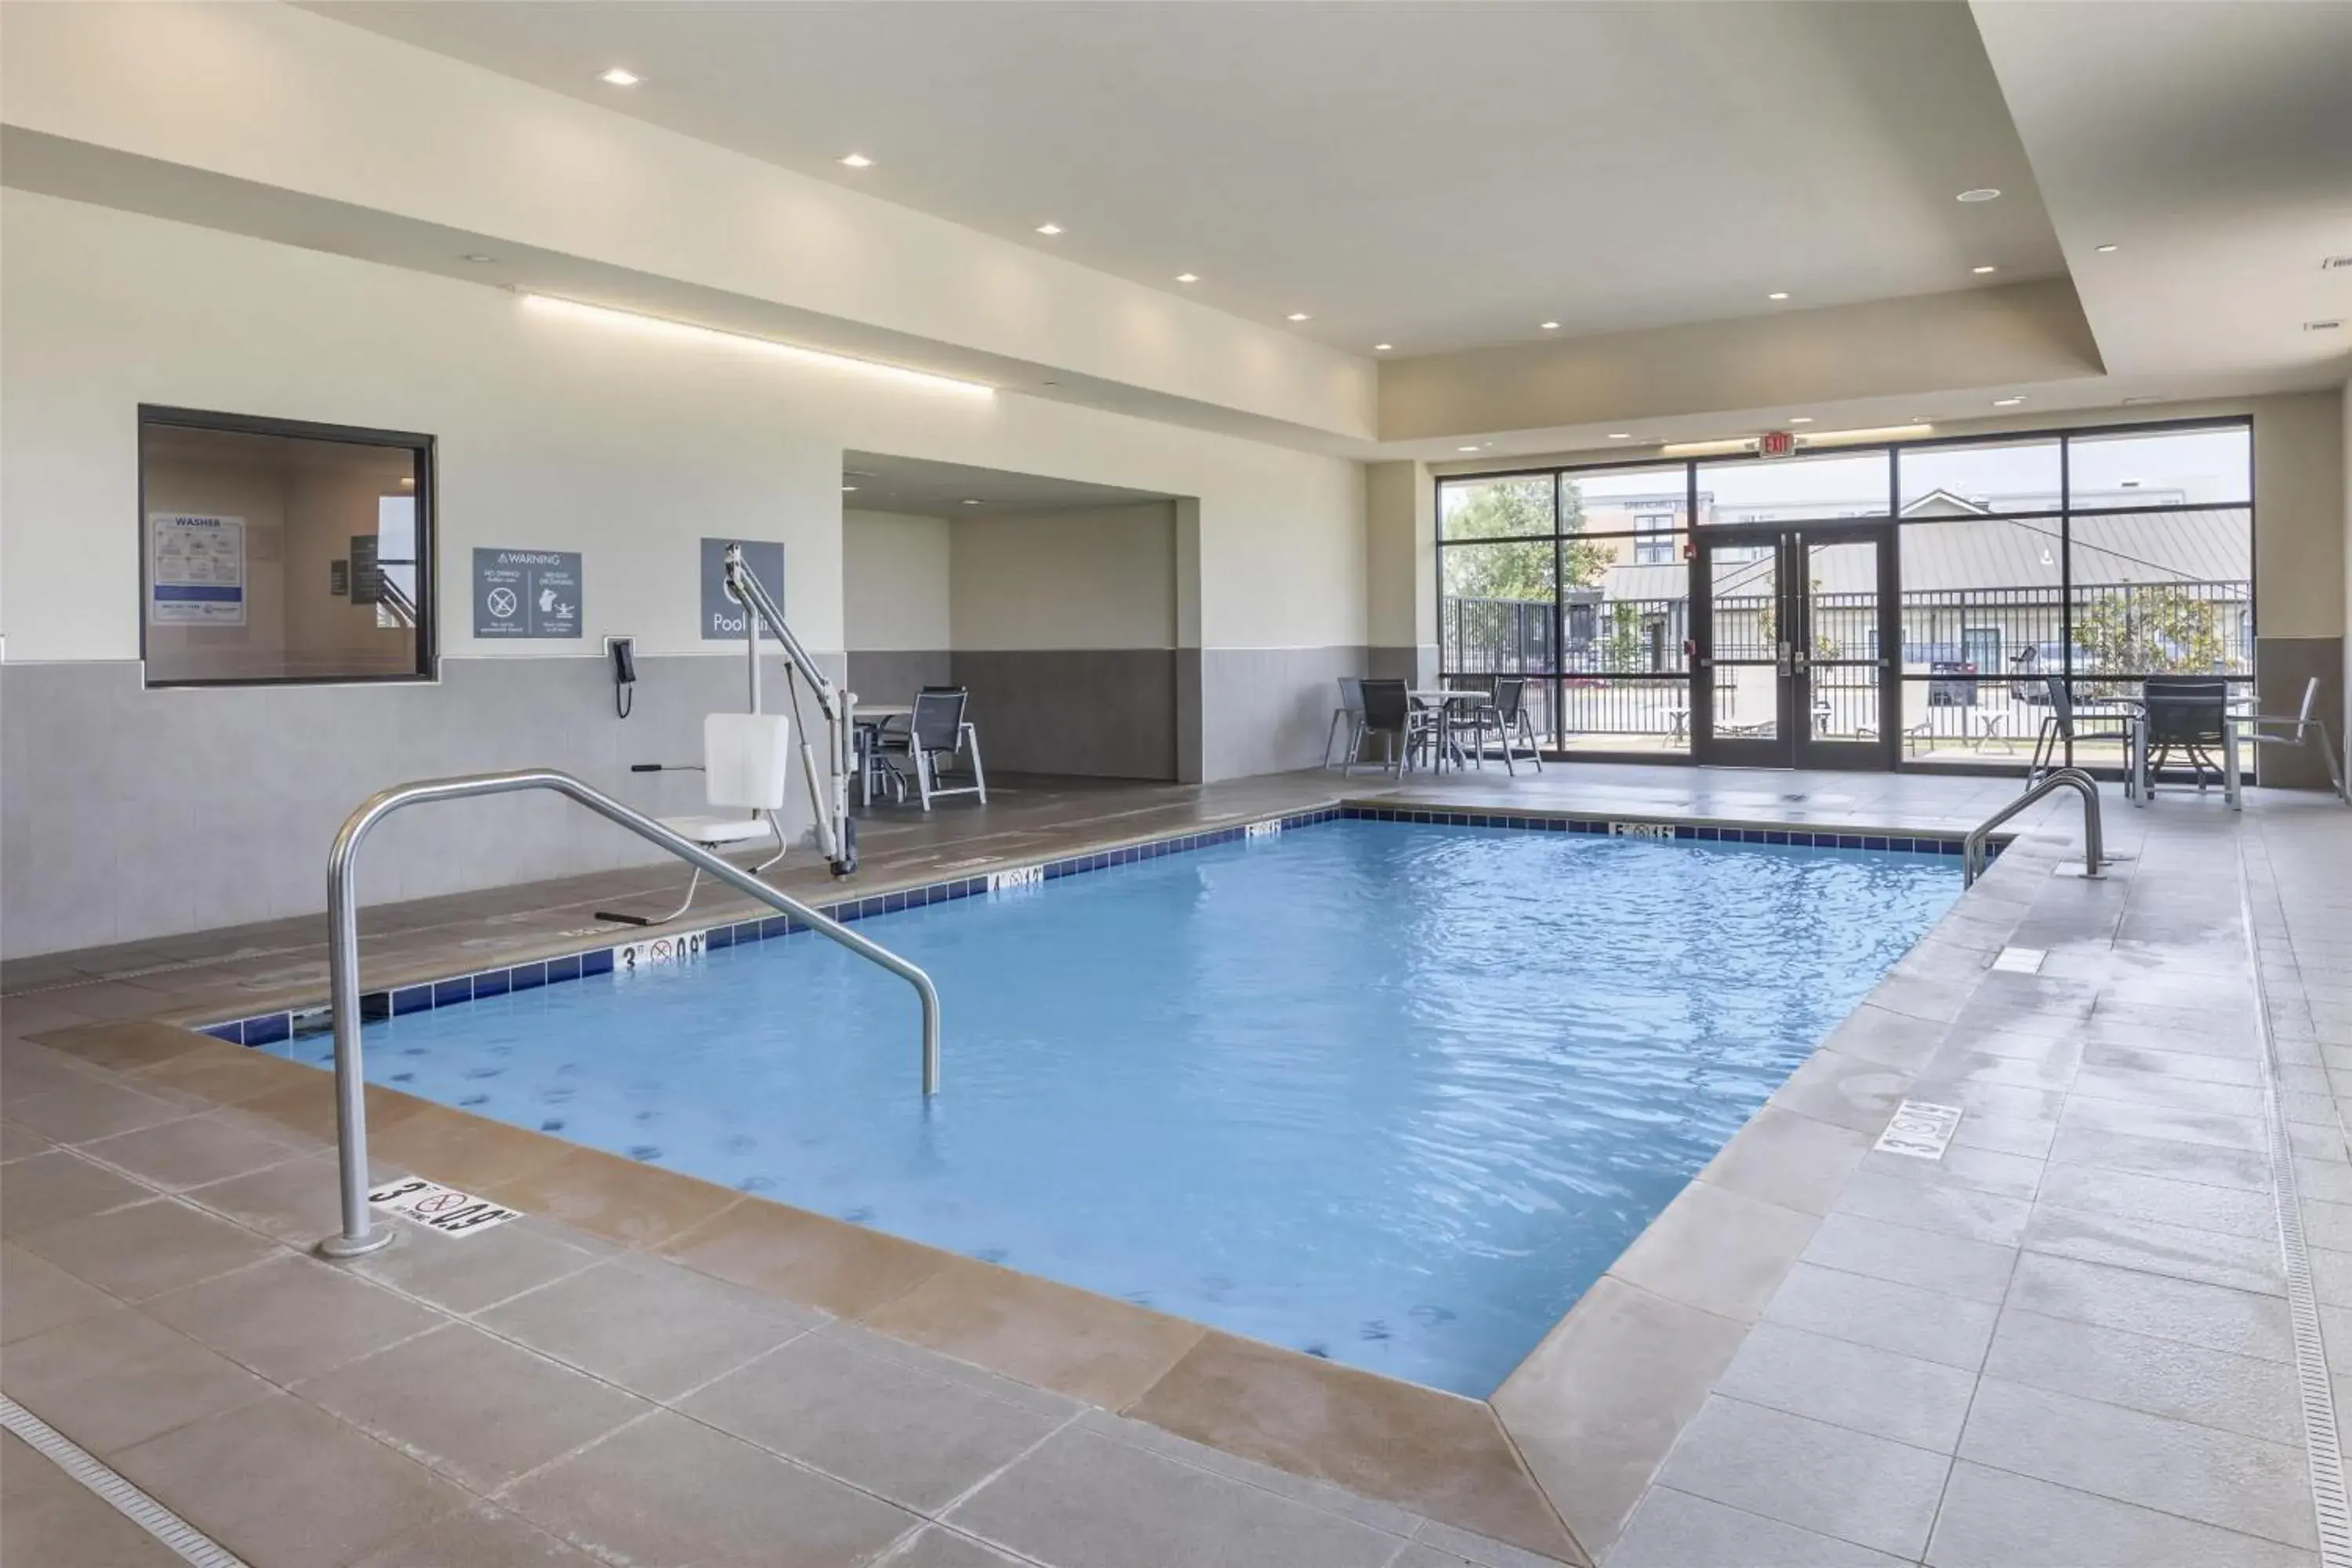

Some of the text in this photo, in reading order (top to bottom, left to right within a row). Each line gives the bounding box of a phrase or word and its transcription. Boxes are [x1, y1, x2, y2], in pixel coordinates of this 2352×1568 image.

[1764, 435, 1788, 452] EXIT
[174, 517, 221, 528] WASHER
[508, 554, 561, 565] WARNING
[714, 612, 746, 631] Pool
